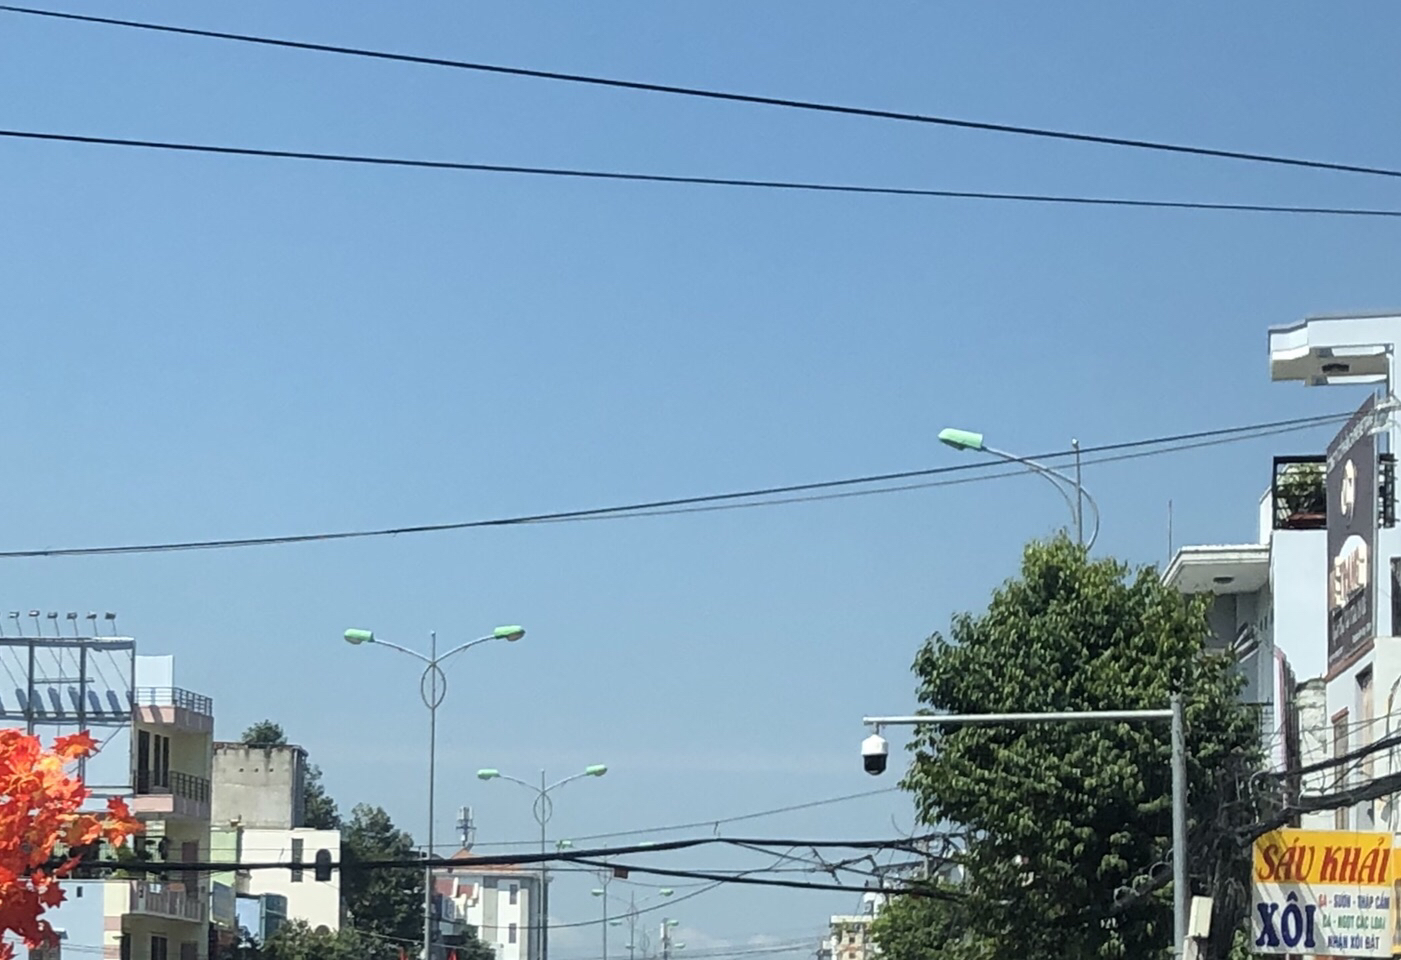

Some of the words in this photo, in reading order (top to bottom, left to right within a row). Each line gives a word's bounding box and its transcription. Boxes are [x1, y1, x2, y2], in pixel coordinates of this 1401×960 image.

[1257, 837, 1316, 881] SÁU
[1319, 837, 1391, 883] KHẢI
[1255, 891, 1316, 948] XÔI
